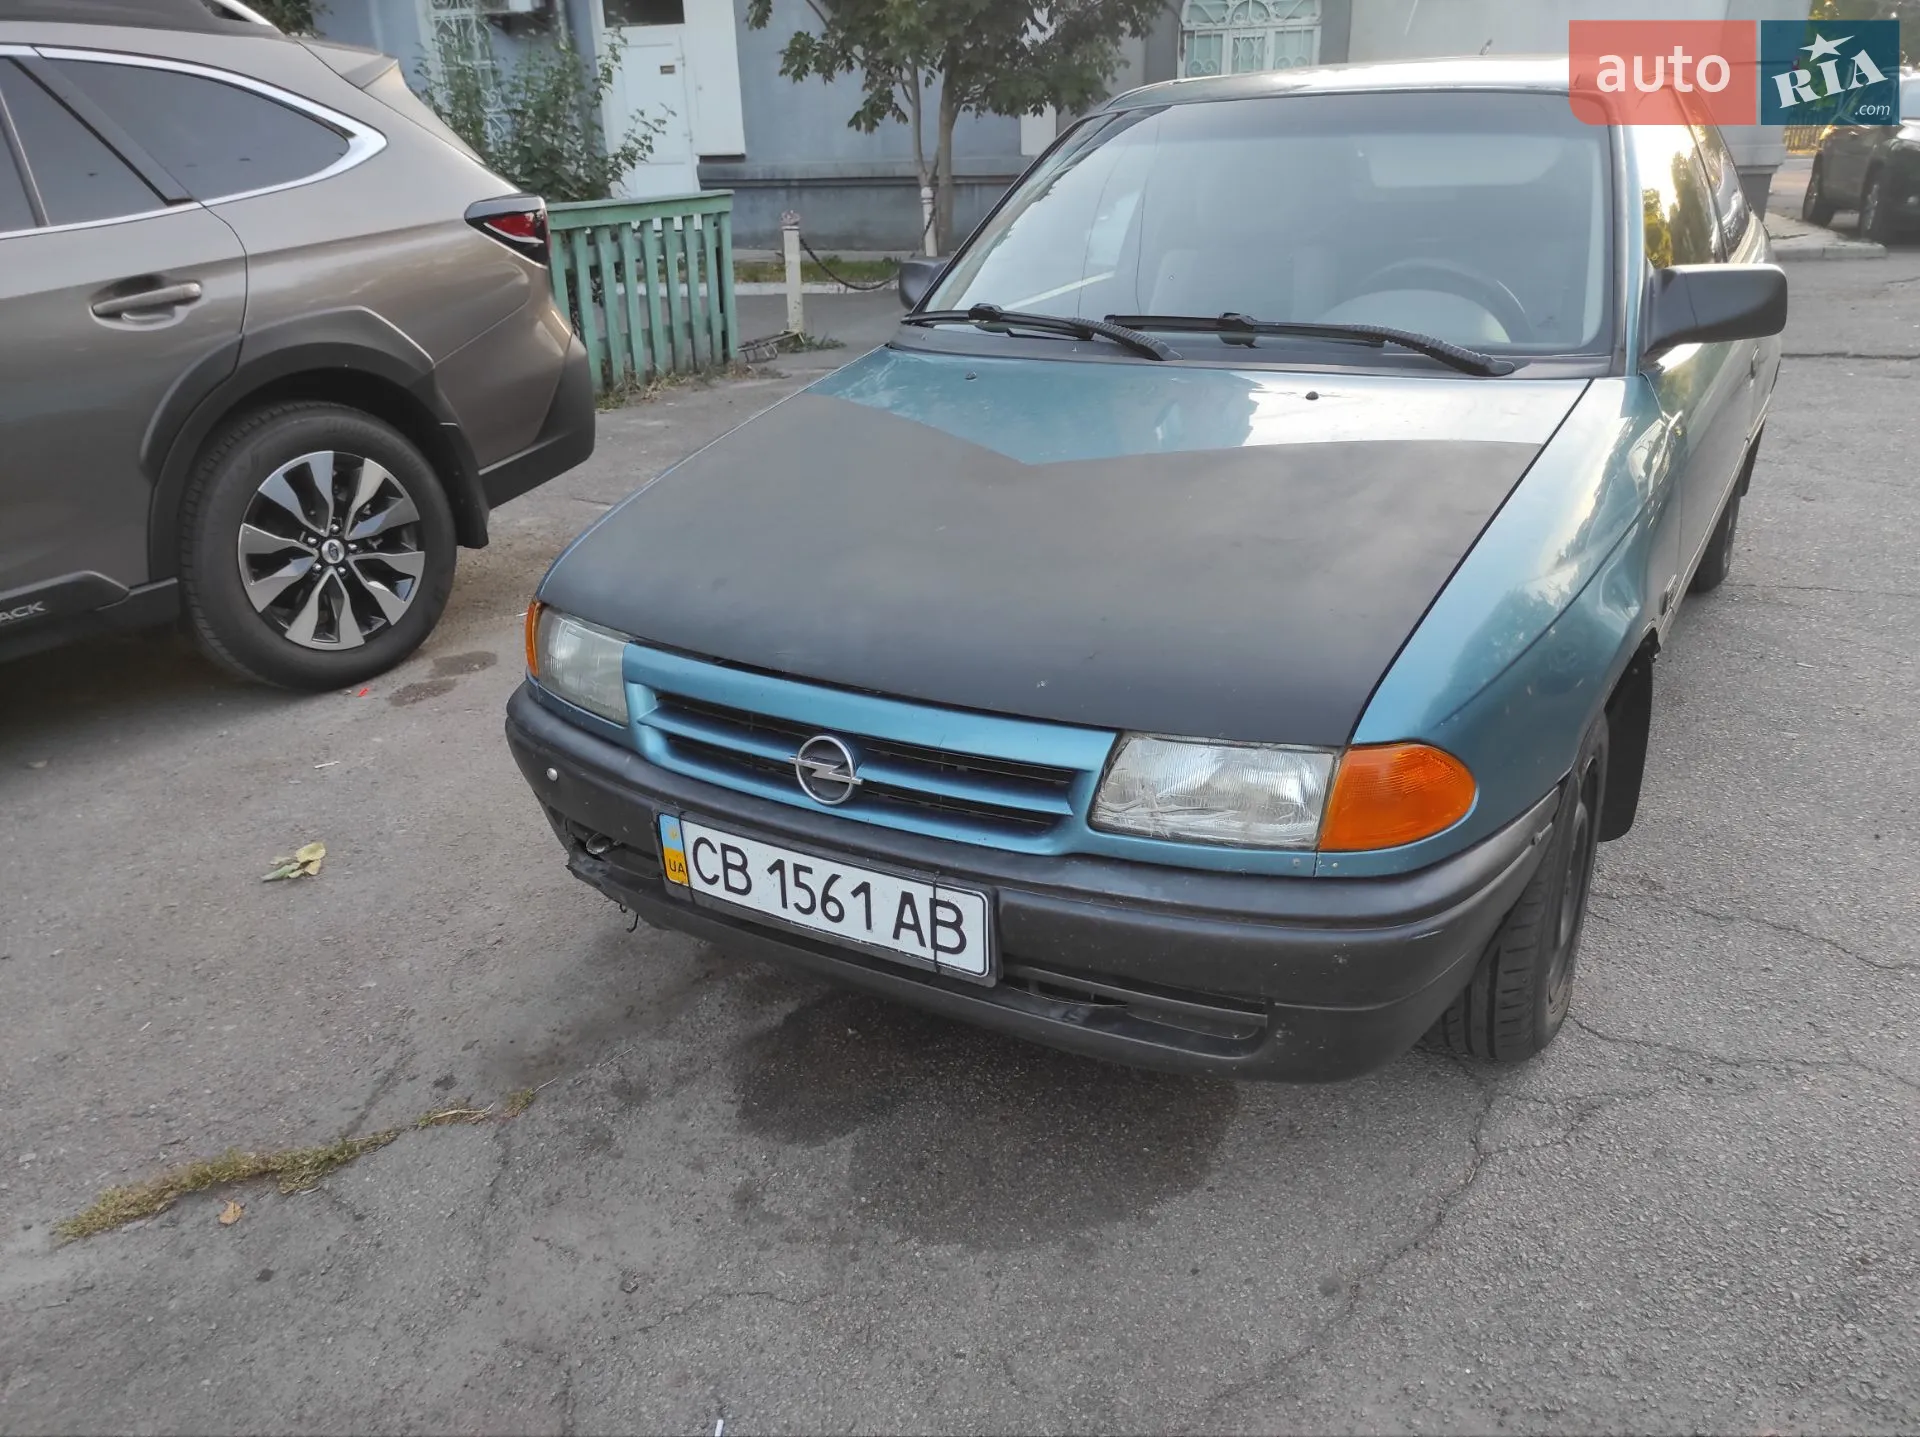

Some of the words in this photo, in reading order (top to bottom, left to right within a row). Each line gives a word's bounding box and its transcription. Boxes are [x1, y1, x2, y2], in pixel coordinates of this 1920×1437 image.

[669, 858, 686, 876] UA
[692, 836, 752, 896] CB
[766, 859, 872, 930] 1561
[892, 891, 968, 955] AB
